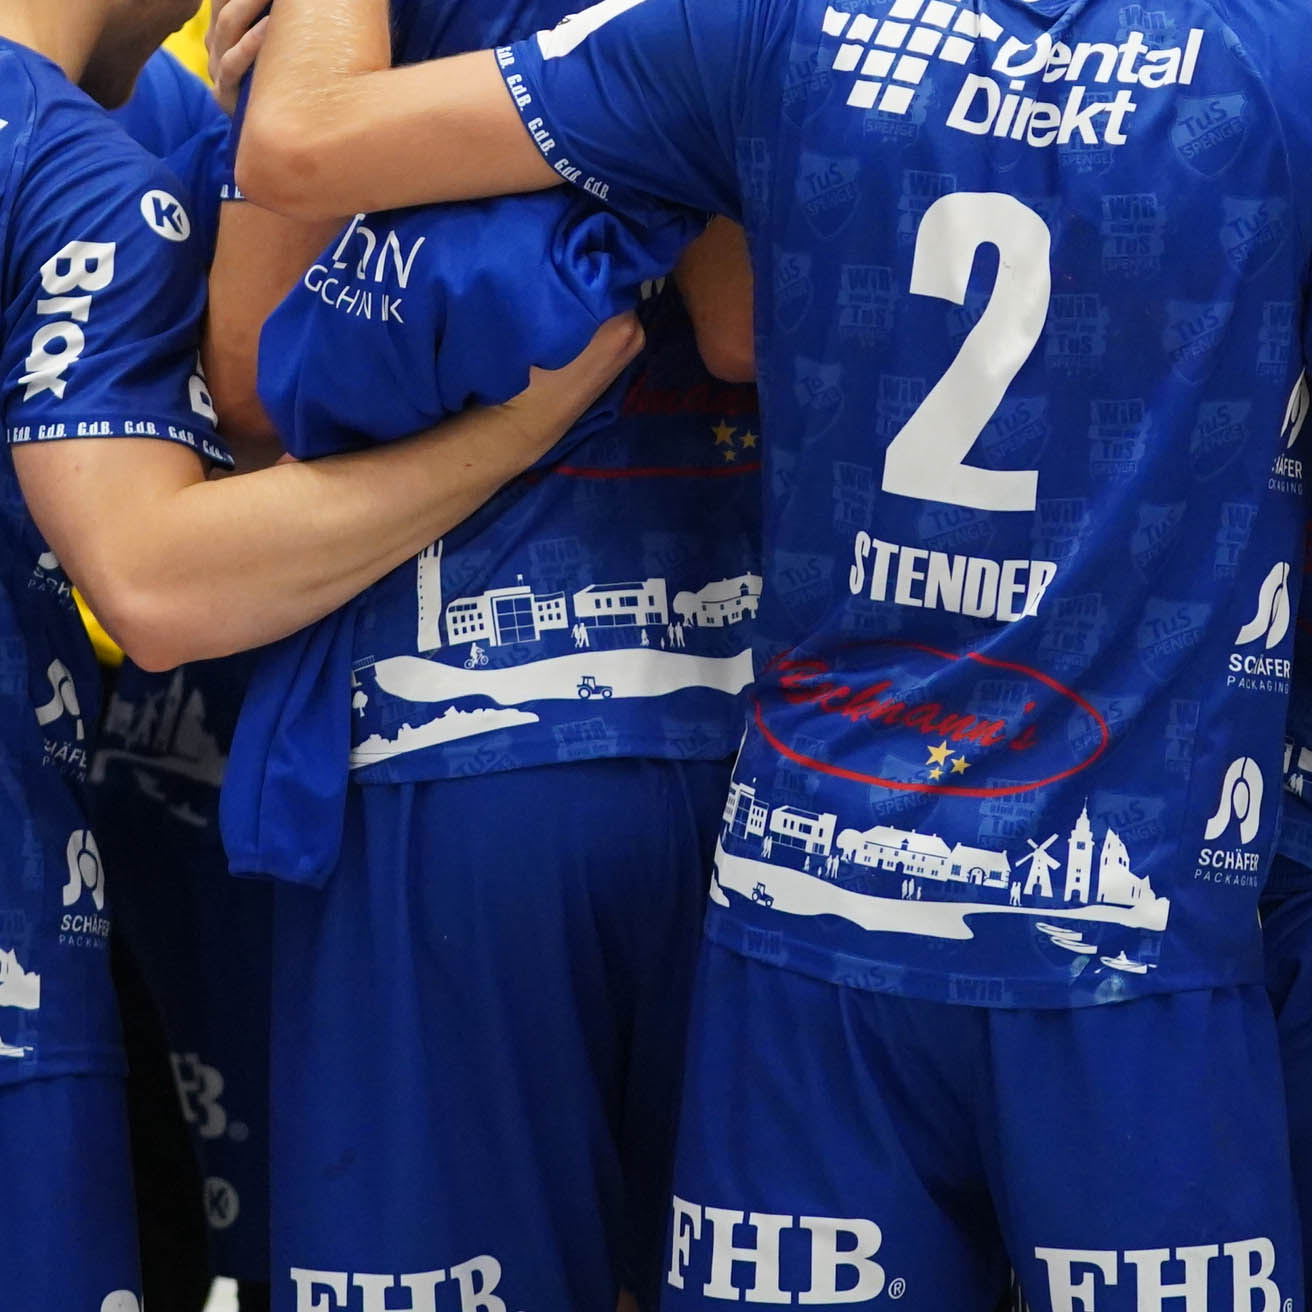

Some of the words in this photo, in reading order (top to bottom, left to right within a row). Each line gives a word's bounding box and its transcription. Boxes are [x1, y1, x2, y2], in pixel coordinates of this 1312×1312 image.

[992, 28, 1204, 88] Dental
[945, 73, 1136, 148] Direkt
[18, 240, 116, 402] Brax
[881, 191, 1051, 511] 2
[849, 530, 1057, 623] STENDER
[1198, 848, 1259, 872] SCHÄFER
